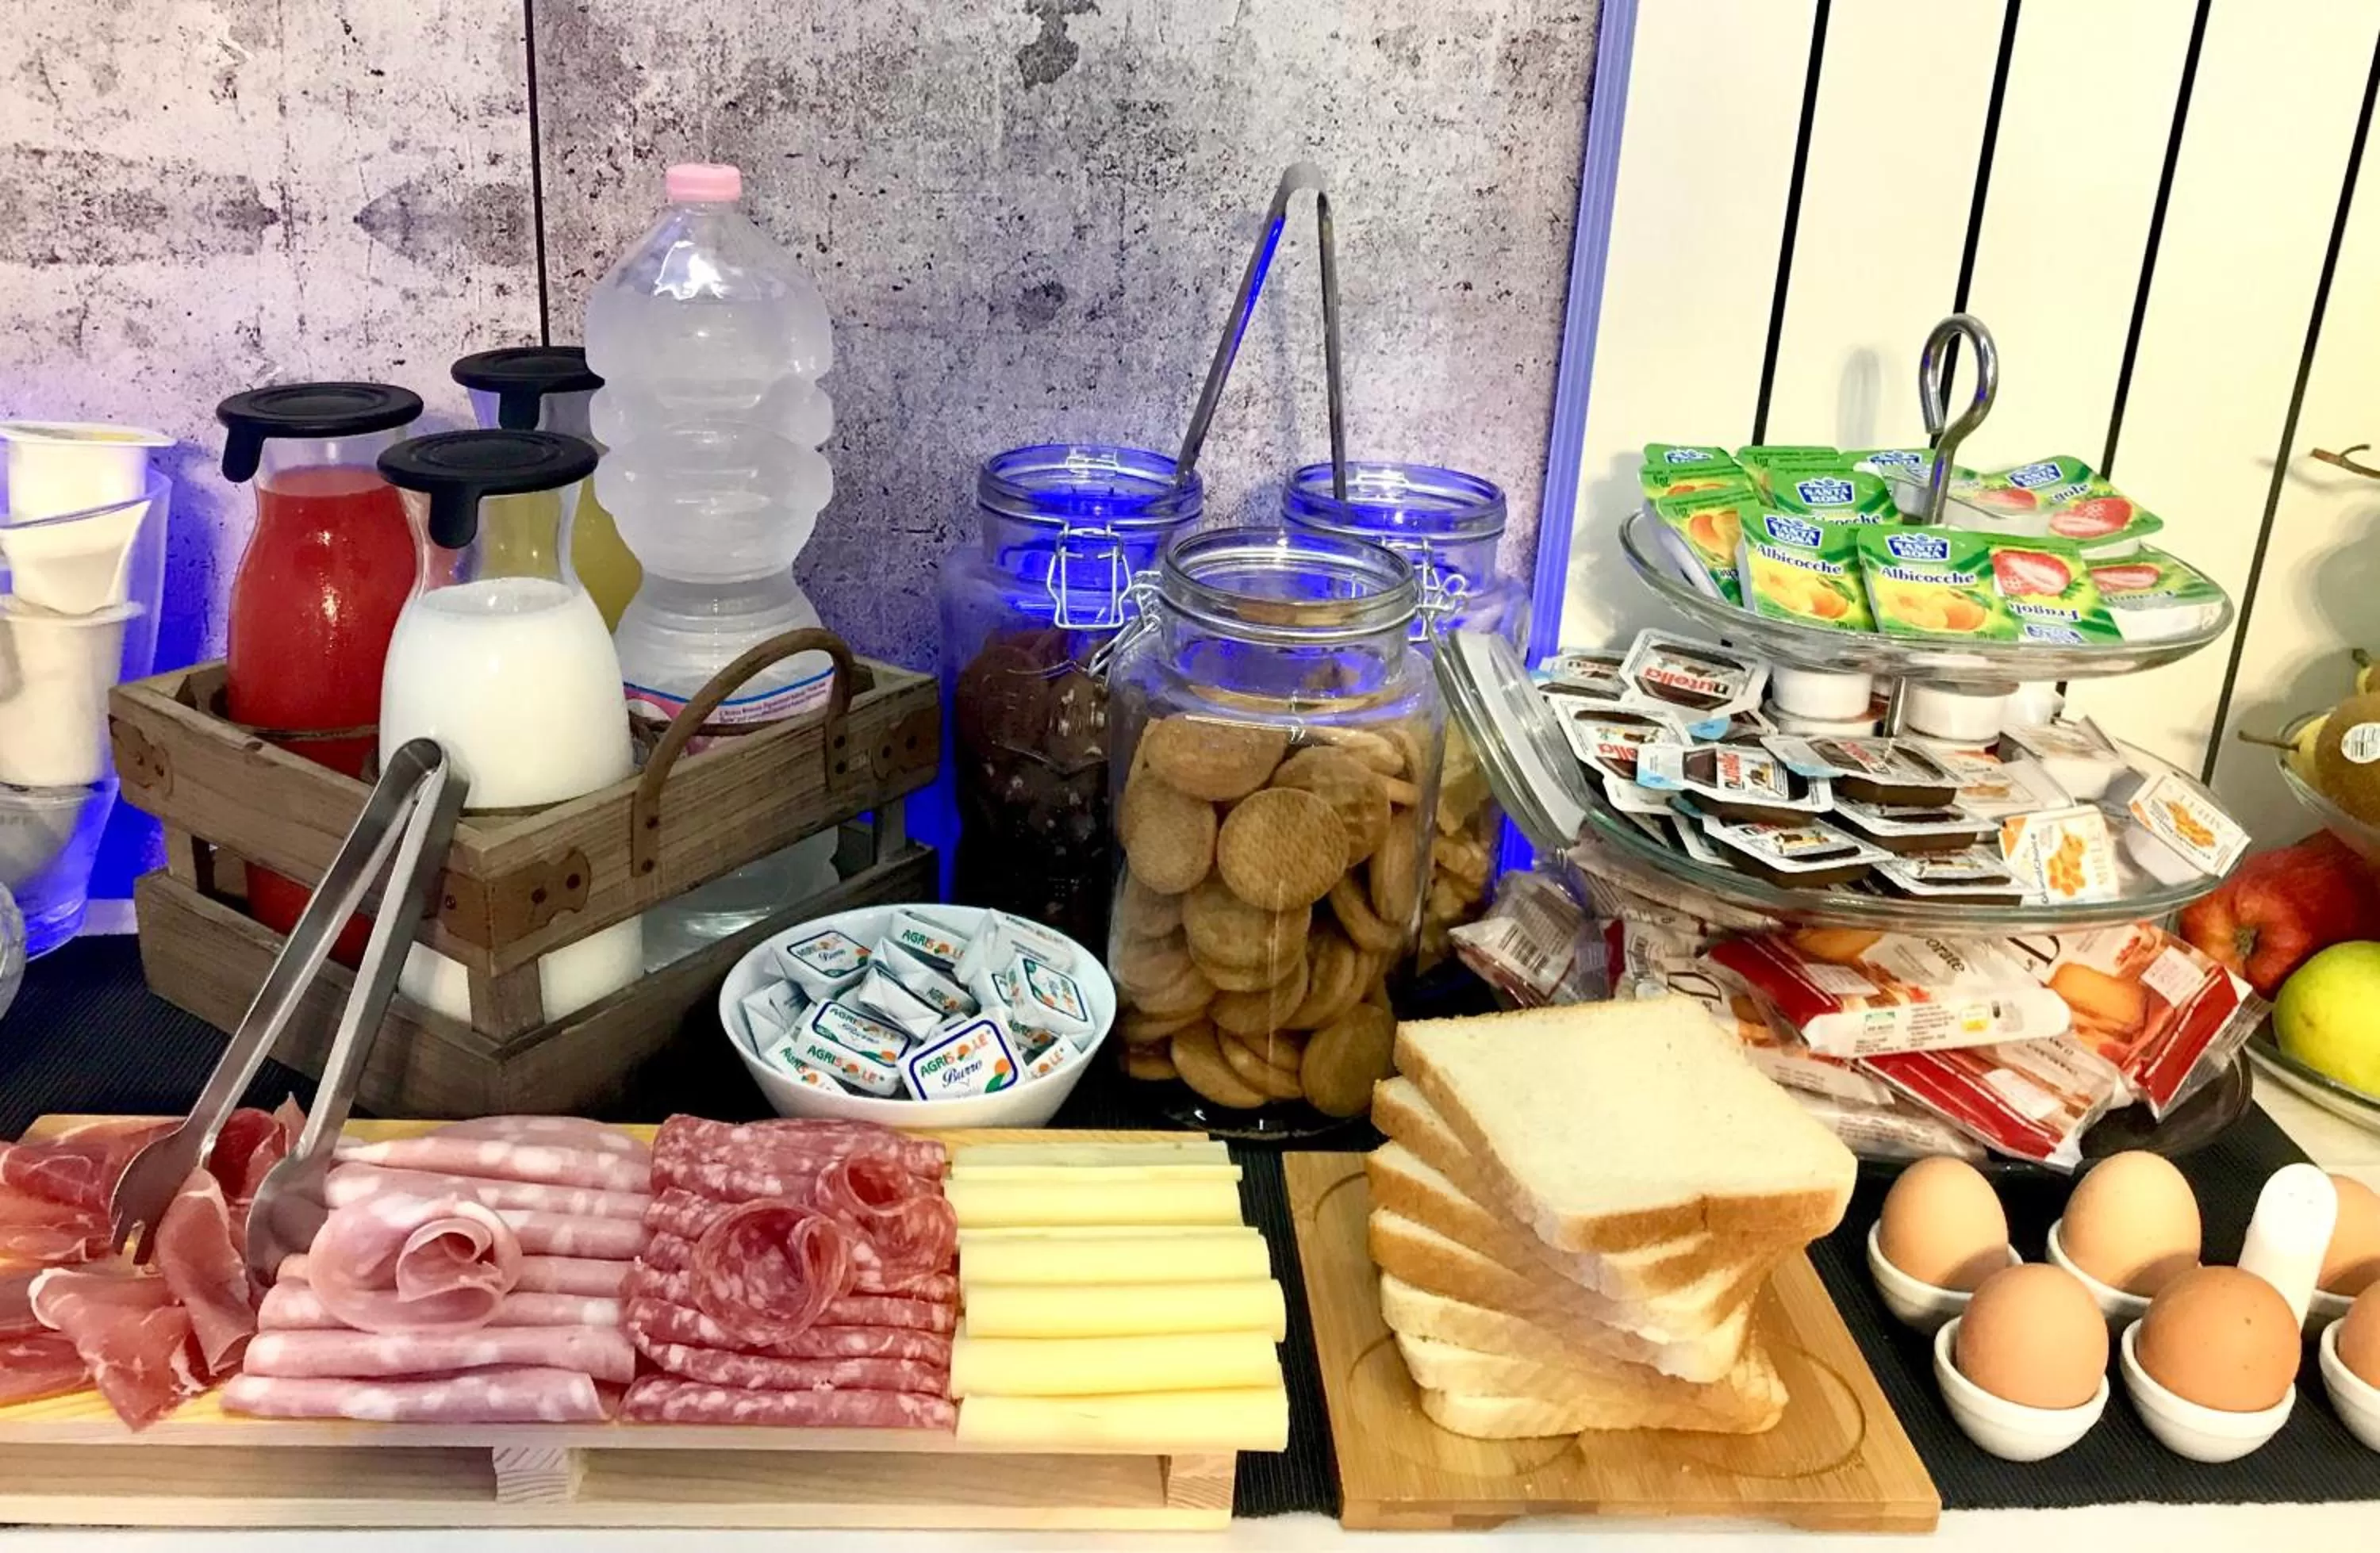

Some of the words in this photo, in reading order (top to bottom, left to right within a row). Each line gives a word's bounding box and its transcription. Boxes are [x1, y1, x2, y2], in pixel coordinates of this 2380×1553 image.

[1757, 543, 1842, 574] Albicocche
[1881, 566, 1975, 584] Albicocche
[1644, 666, 1729, 695] nutella
[942, 1059, 983, 1087] Burro
